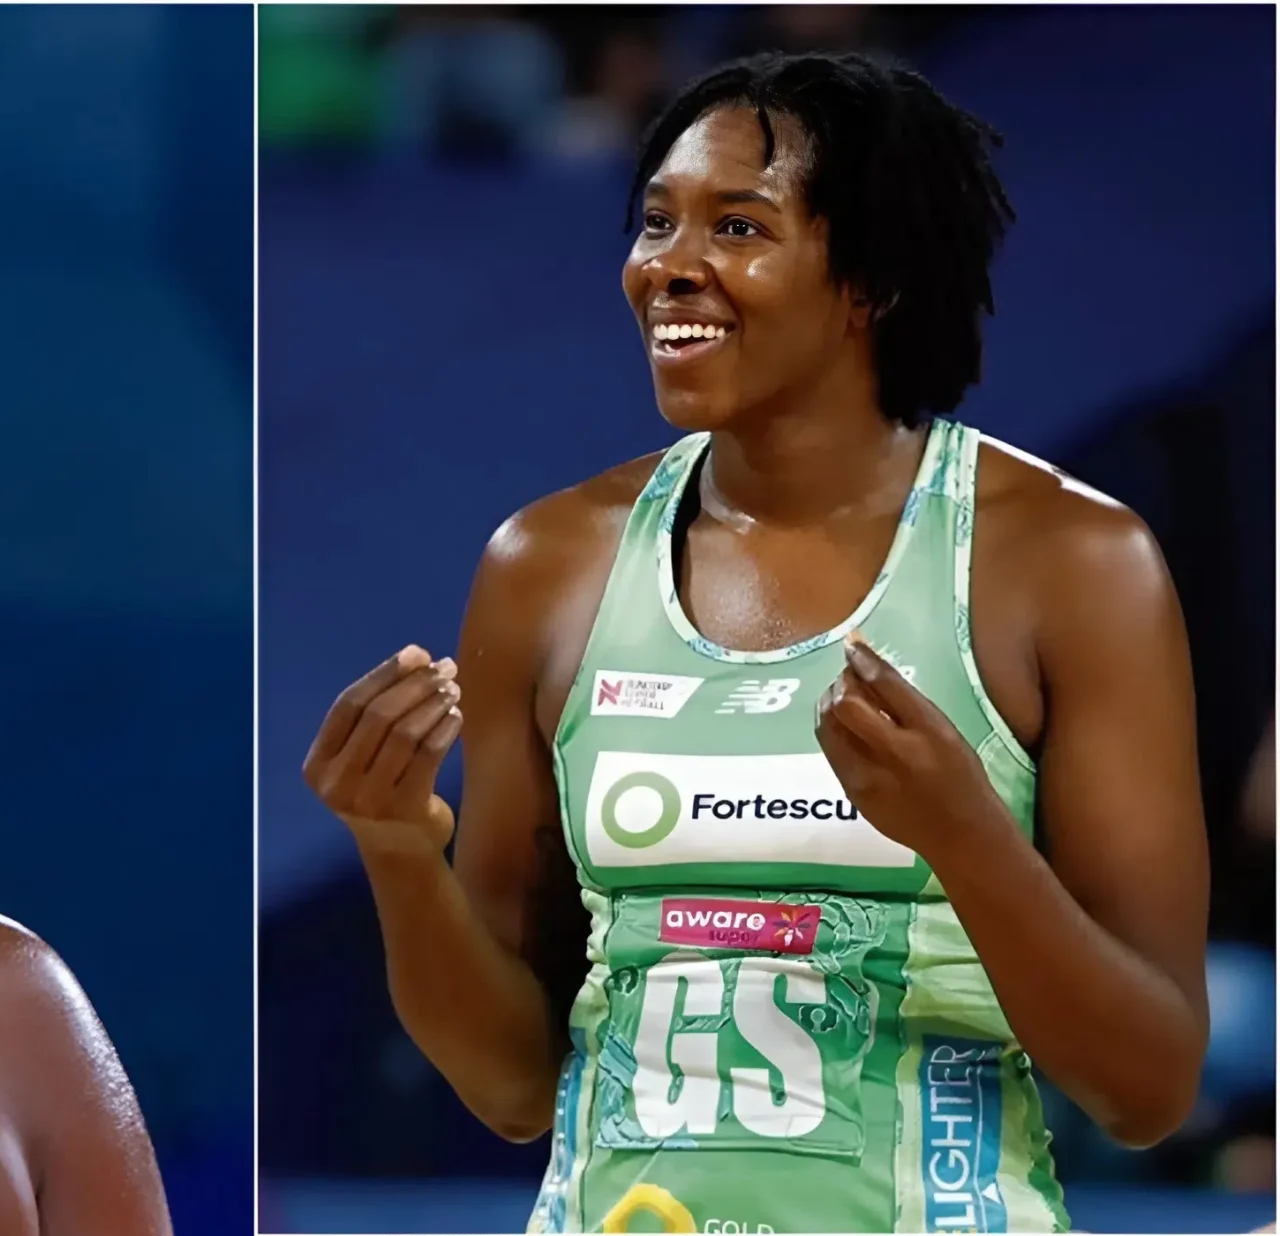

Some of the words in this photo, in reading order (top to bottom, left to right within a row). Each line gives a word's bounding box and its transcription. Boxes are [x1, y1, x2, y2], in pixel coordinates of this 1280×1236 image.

[667, 910, 766, 931] aware
[632, 953, 827, 1138] GS
[927, 1045, 977, 1233] LIGHTER
